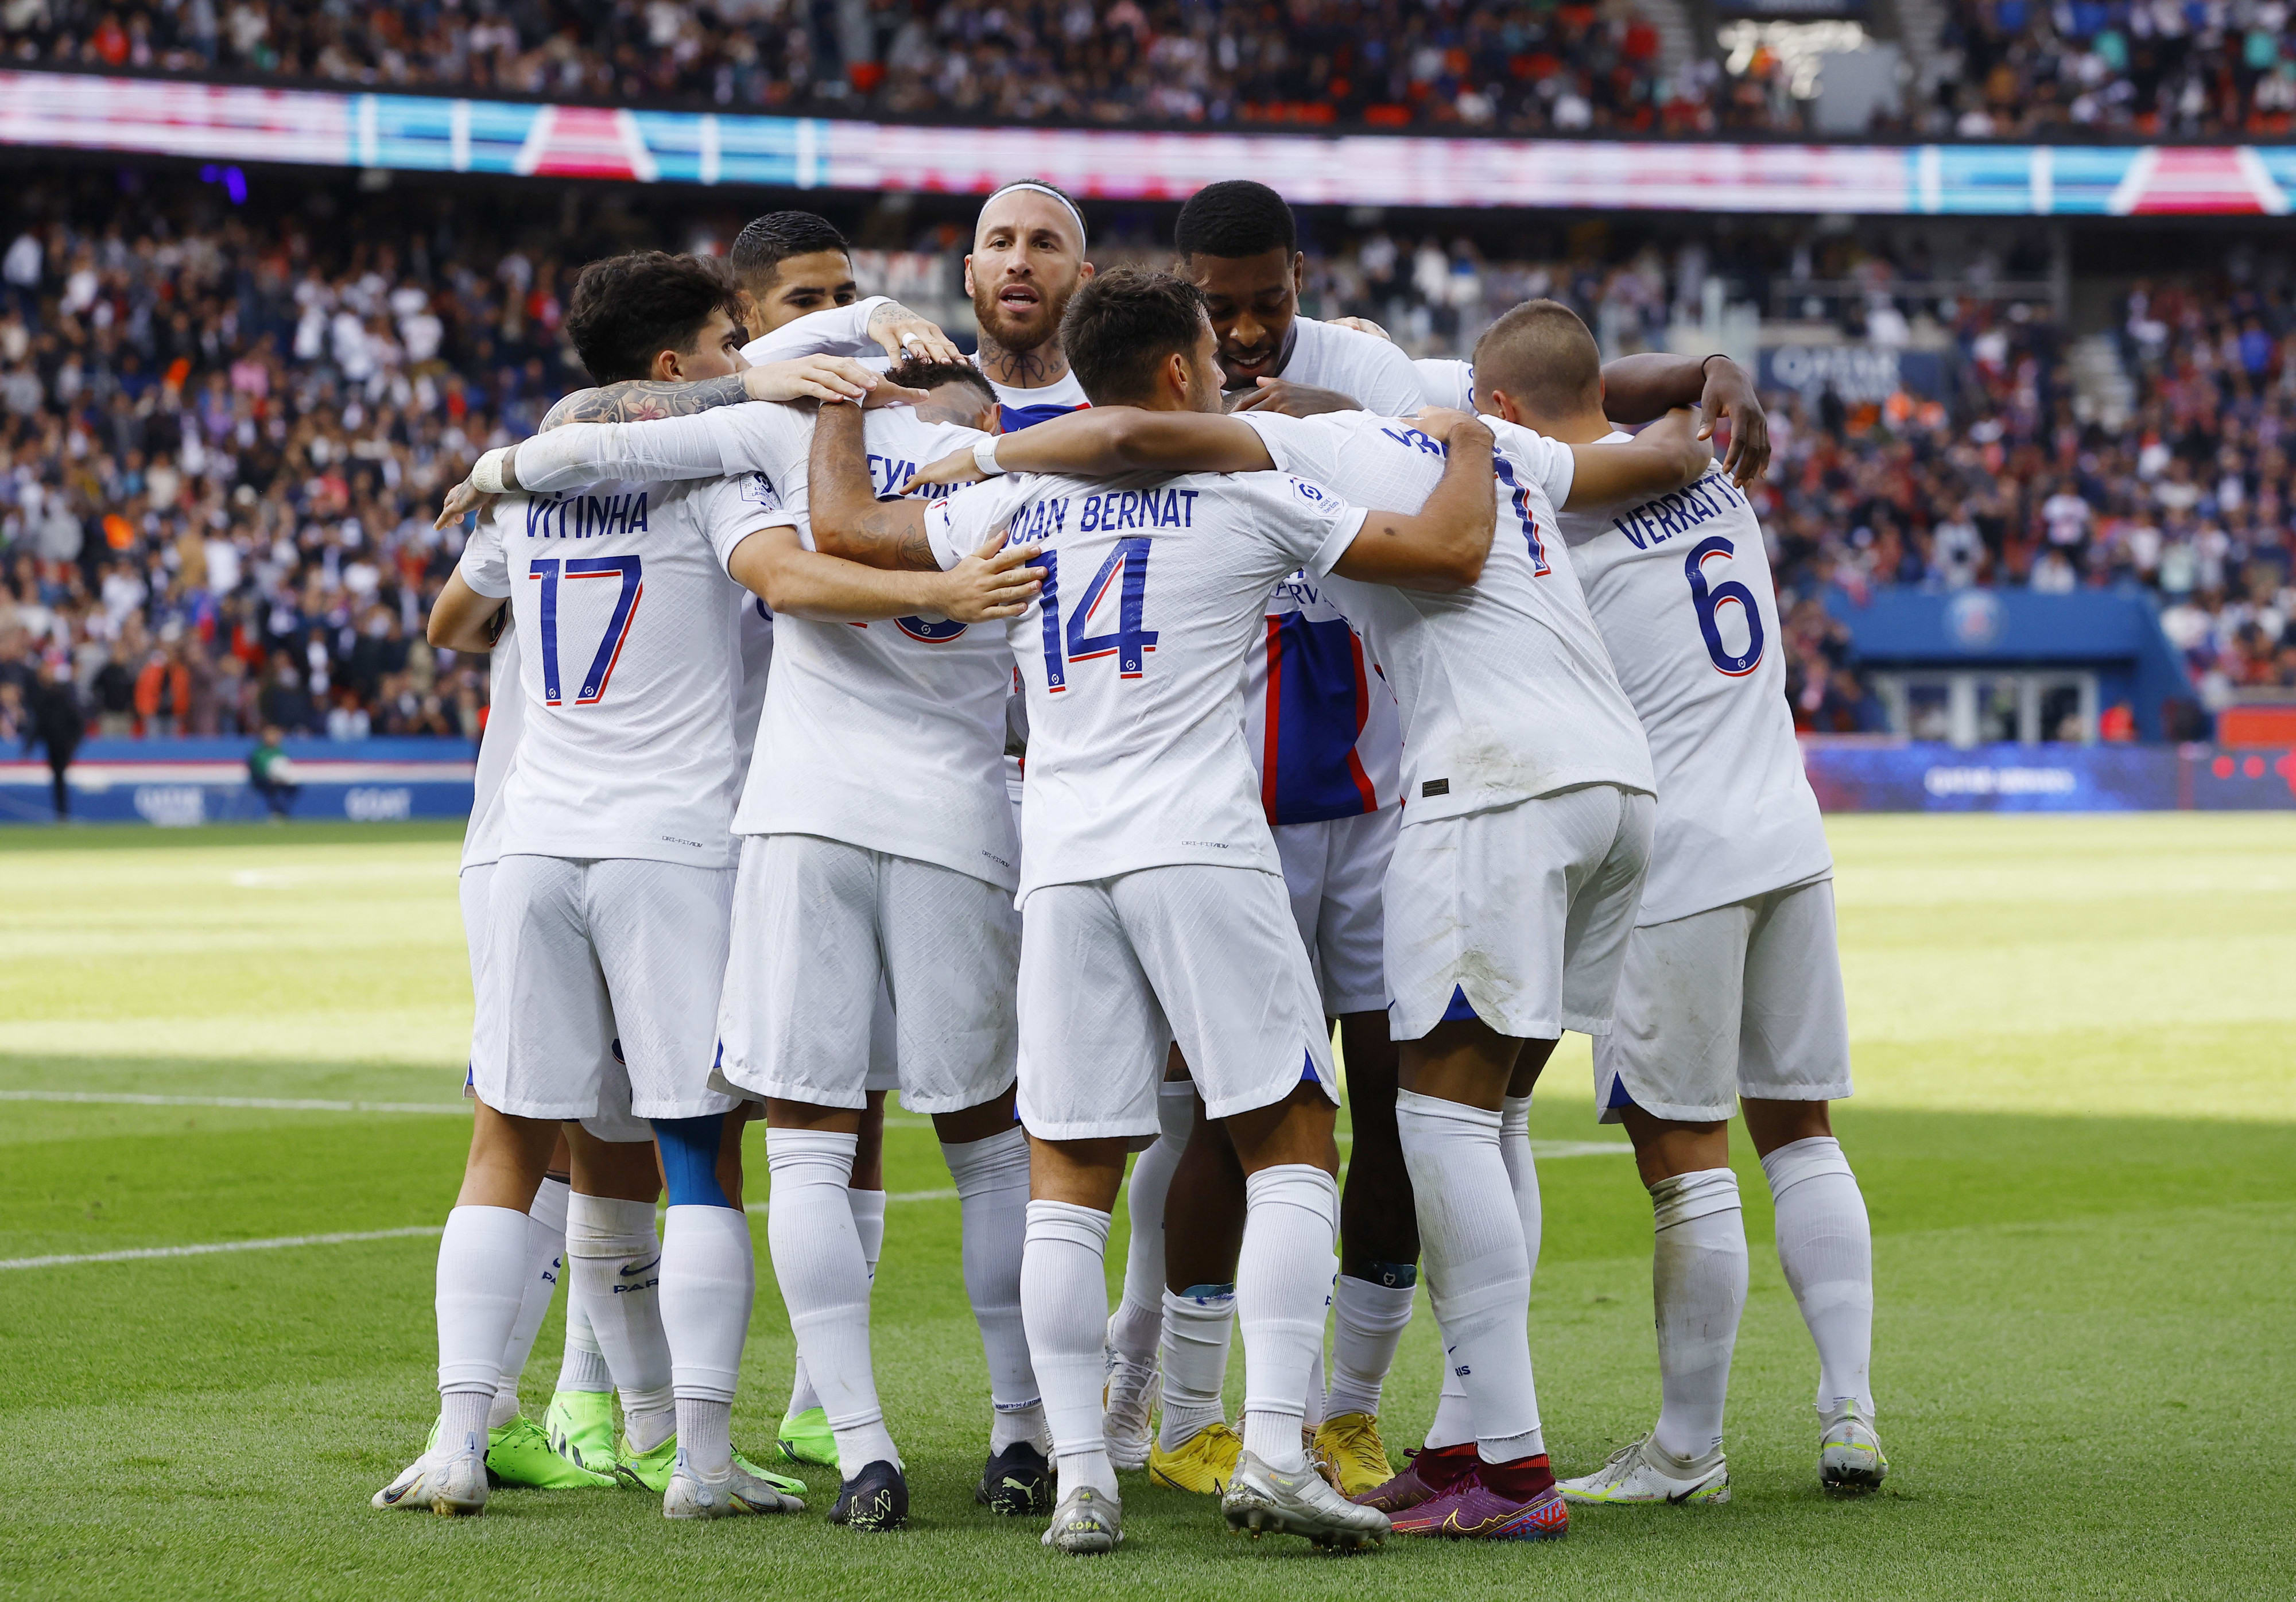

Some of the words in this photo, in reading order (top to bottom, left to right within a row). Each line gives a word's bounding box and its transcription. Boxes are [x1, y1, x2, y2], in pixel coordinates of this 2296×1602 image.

[1004, 498, 1069, 549] JUAN
[1080, 488, 1199, 532] BERNAT
[1612, 472, 1745, 550] VERRATTI
[529, 555, 643, 706] 17
[1025, 537, 1159, 693] 14
[1685, 536, 1764, 677] 6
[614, 1278, 659, 1294] PAR
[1455, 1365, 1471, 1377] RIS
[1068, 1520, 1100, 1531] COPA
